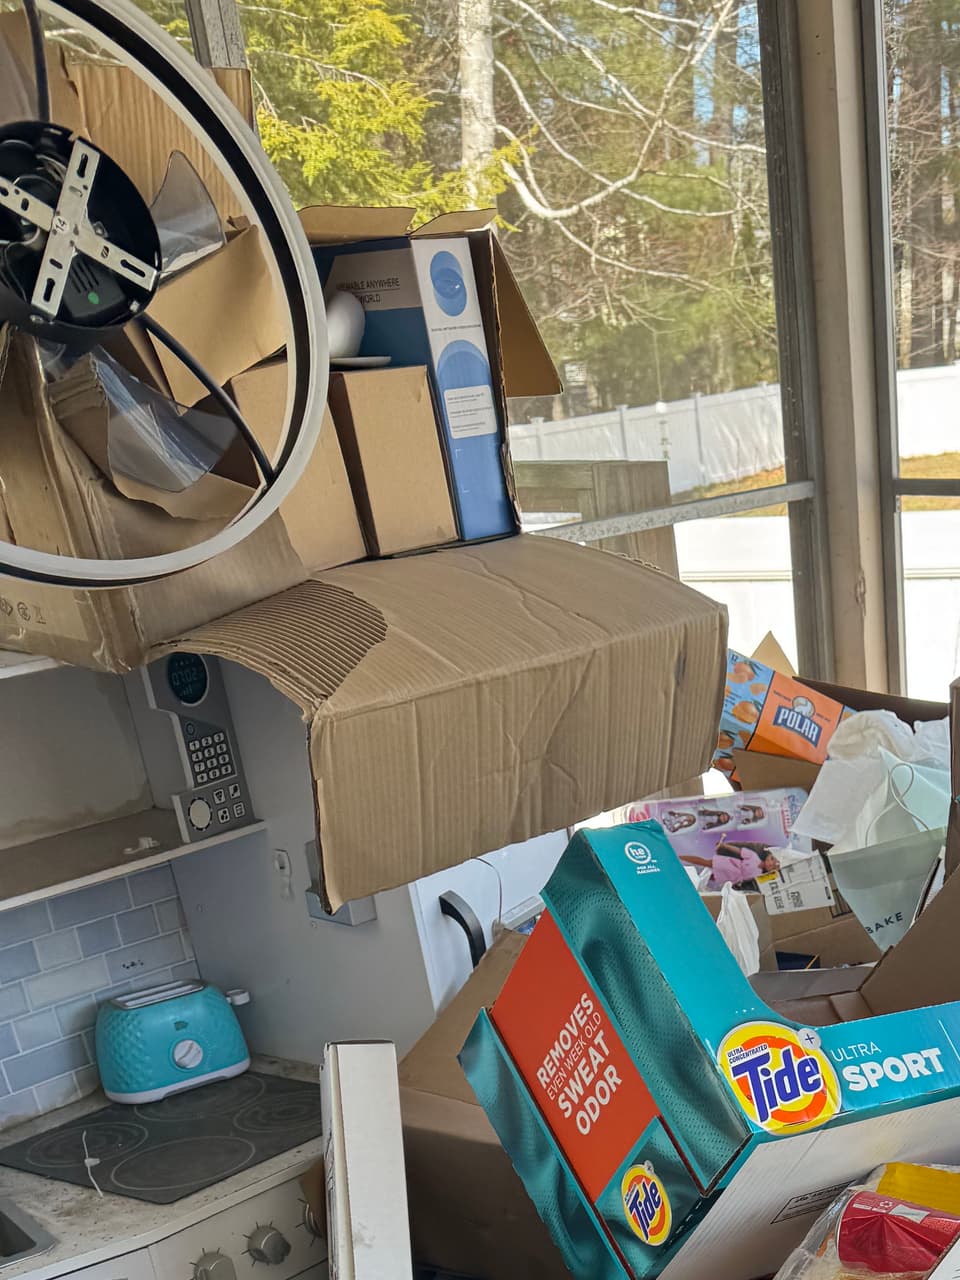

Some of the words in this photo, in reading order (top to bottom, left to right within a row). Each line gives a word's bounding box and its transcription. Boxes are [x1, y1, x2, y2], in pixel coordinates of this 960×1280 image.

[777, 709, 819, 742] POLAR
[537, 993, 593, 1088] REMOVES
[547, 1068, 567, 1100] EVEN
[564, 1035, 587, 1070] WEEK
[584, 1012, 601, 1038] OLD
[727, 1047, 744, 1058] ULTRA
[729, 1044, 768, 1064] CONCENTRATED
[831, 1041, 881, 1063] ULTRA
[842, 1047, 944, 1092] SPORT
[558, 1030, 609, 1118] SWEAT
[576, 1065, 622, 1135] ODOR
[731, 1048, 821, 1123] Tide
[628, 1180, 662, 1242] Tide
